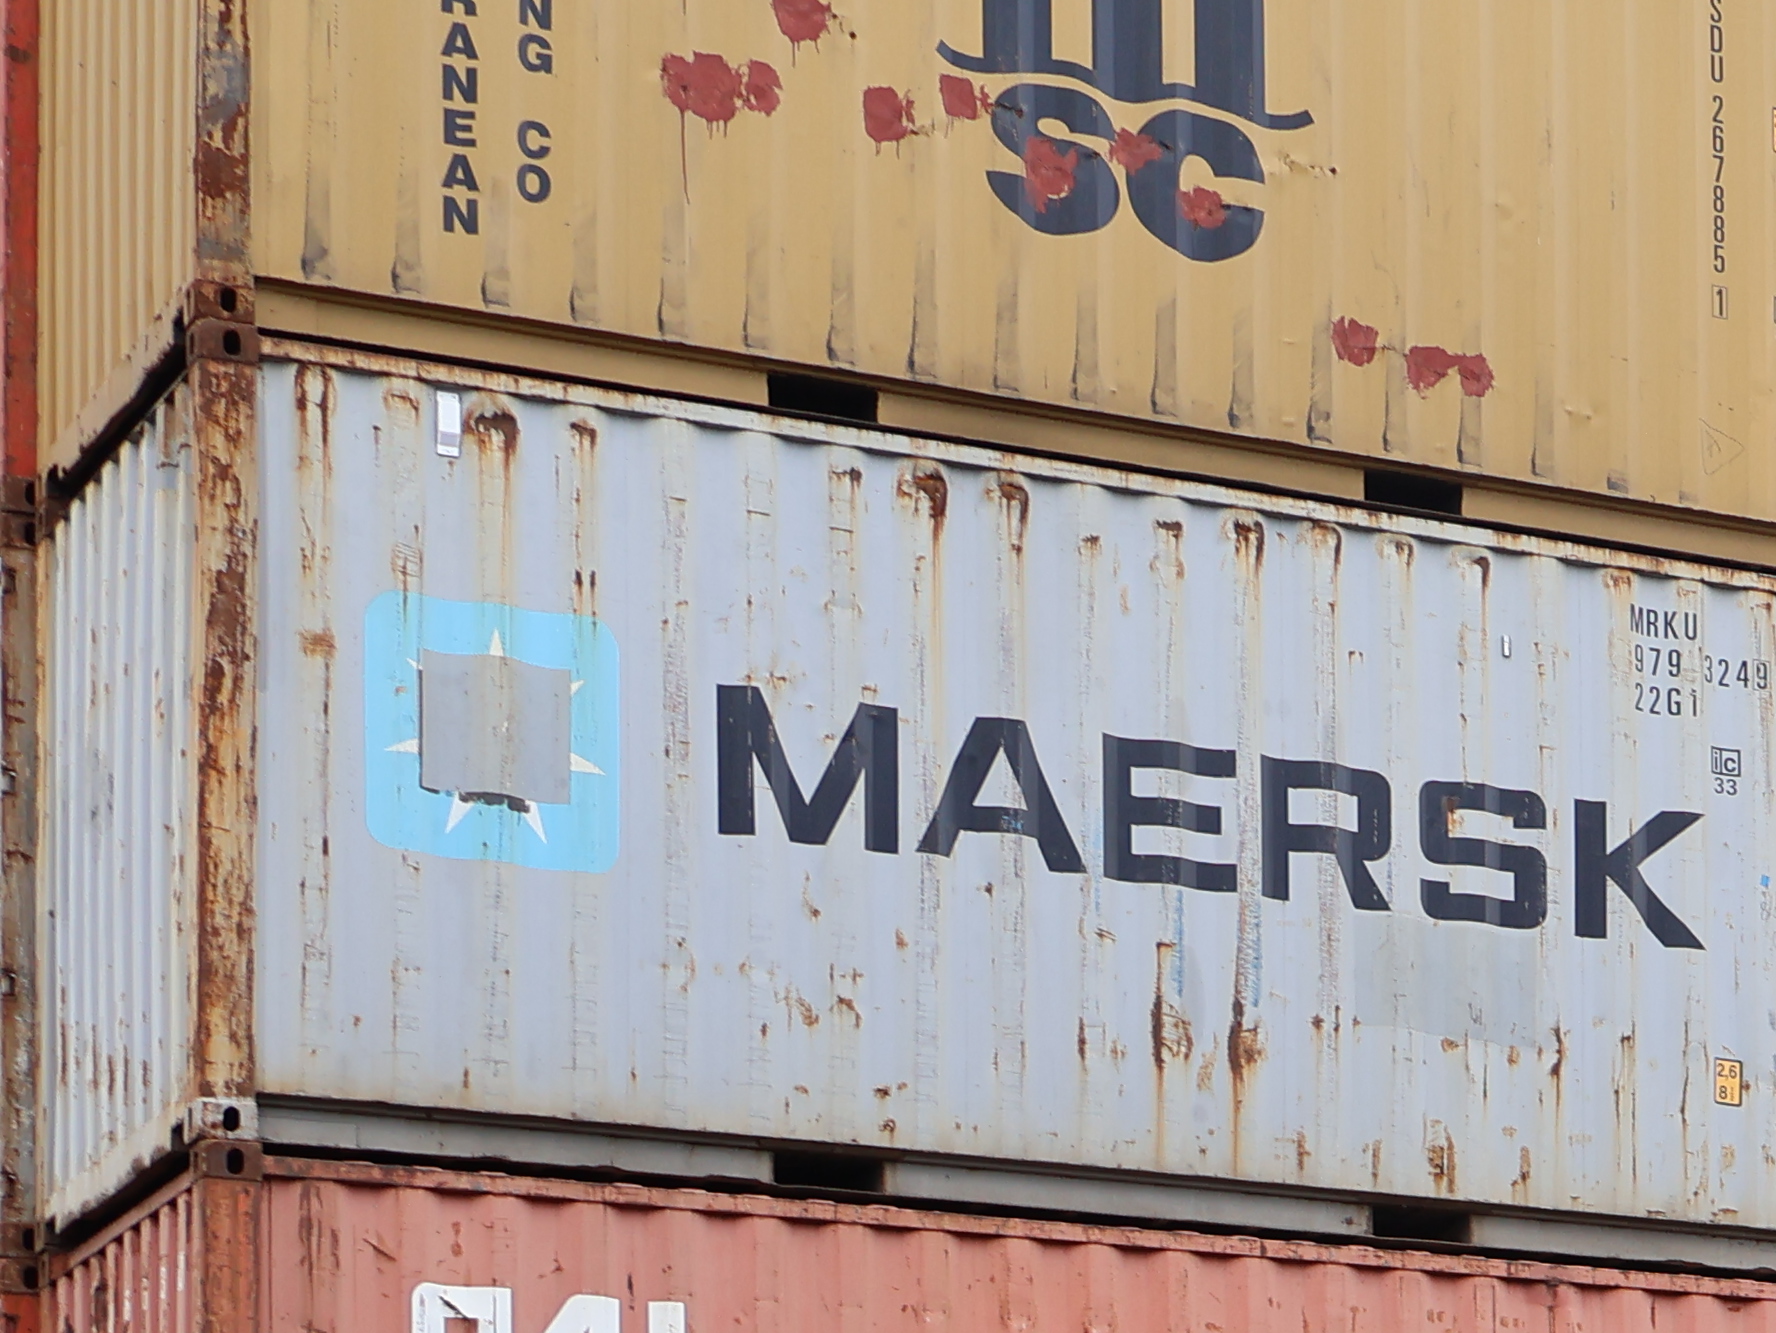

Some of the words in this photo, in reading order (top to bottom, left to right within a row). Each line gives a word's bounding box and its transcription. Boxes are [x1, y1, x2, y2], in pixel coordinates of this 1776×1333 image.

[1711, 95, 1725, 274] 267885
[1629, 603, 1698, 641] MRKU
[1634, 644, 1682, 678] 979
[1713, 776, 1739, 795] 33
[715, 683, 1707, 952] MAERSK
